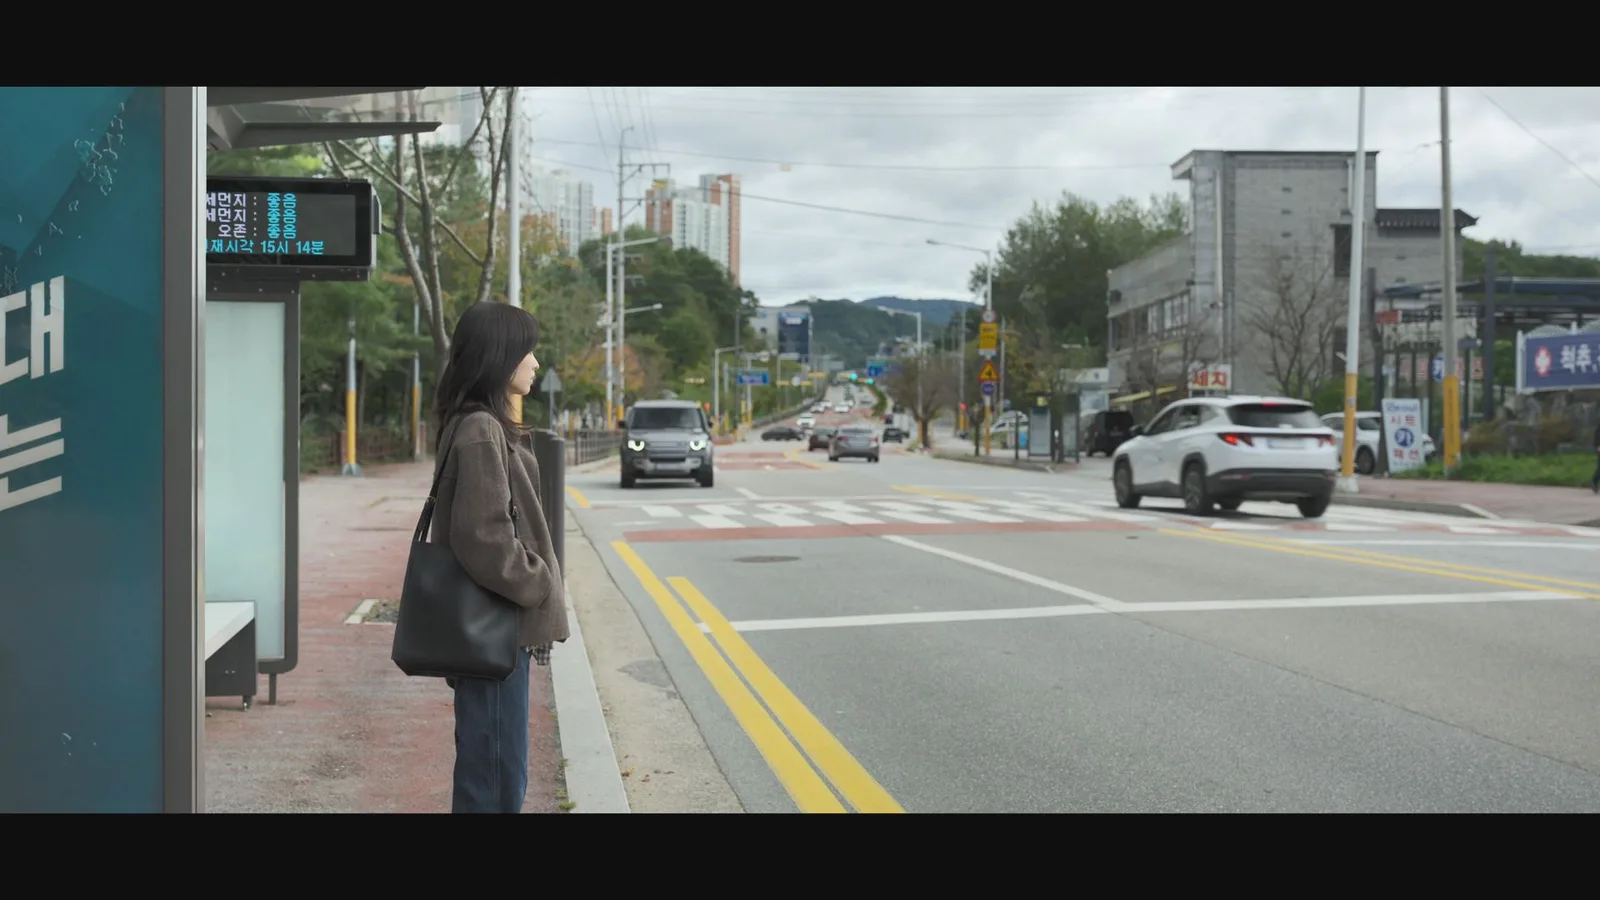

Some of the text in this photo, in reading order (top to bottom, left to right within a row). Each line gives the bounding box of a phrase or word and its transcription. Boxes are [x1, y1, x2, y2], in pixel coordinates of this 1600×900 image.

[267, 192, 297, 208] 좋음
[267, 209, 297, 224] 좋음
[218, 224, 247, 238] 오존
[267, 224, 297, 239] 좋음
[205, 239, 324, 255] 재시각 15시 14분
[1561, 343, 1600, 374] 척추,
